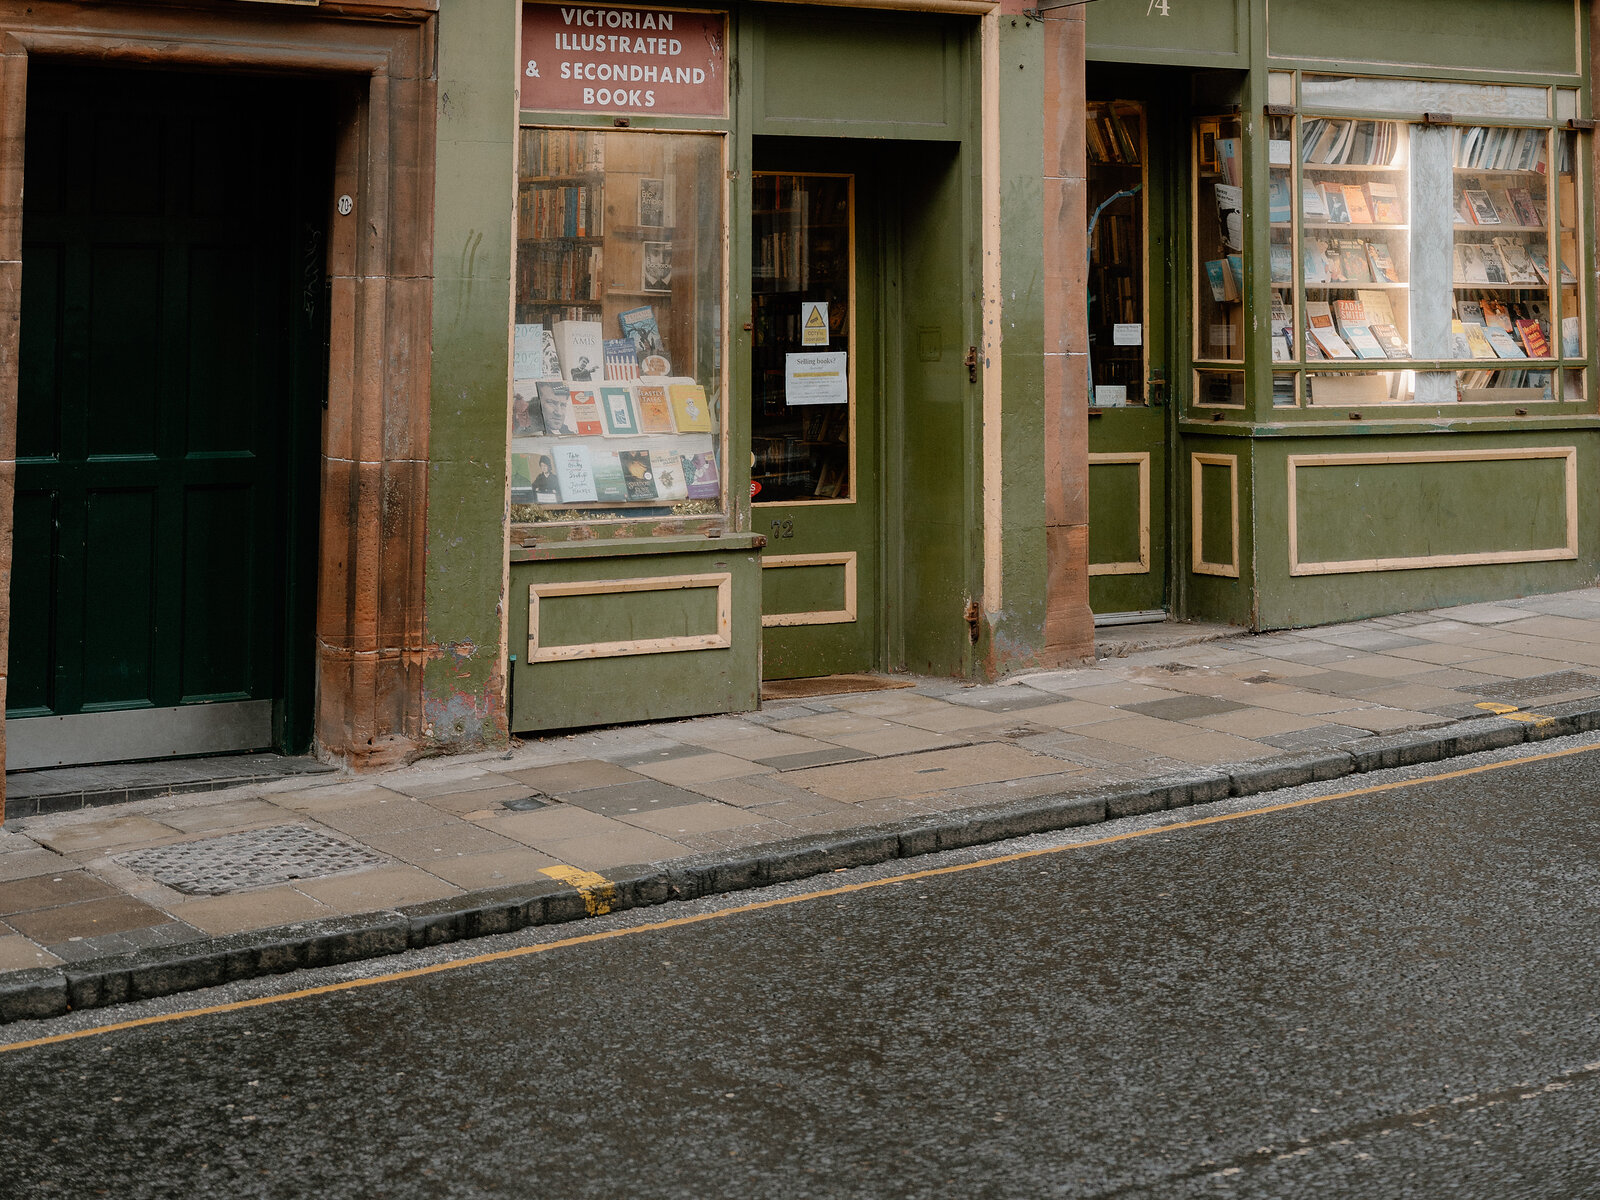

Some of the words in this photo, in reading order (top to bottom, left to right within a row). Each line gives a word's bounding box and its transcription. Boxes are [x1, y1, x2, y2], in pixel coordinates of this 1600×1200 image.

[561, 8, 675, 32] VICTORIAN
[554, 32, 683, 57] ILLUSTRATED
[525, 60, 542, 79] &
[560, 62, 706, 85] SECONDHAND
[583, 88, 656, 109] BOOKS
[1340, 302, 1363, 311] ZADIE
[1340, 311, 1366, 320] SMITH
[572, 337, 596, 345] AMIS
[796, 358, 816, 366] Selling
[771, 519, 794, 539] 72
